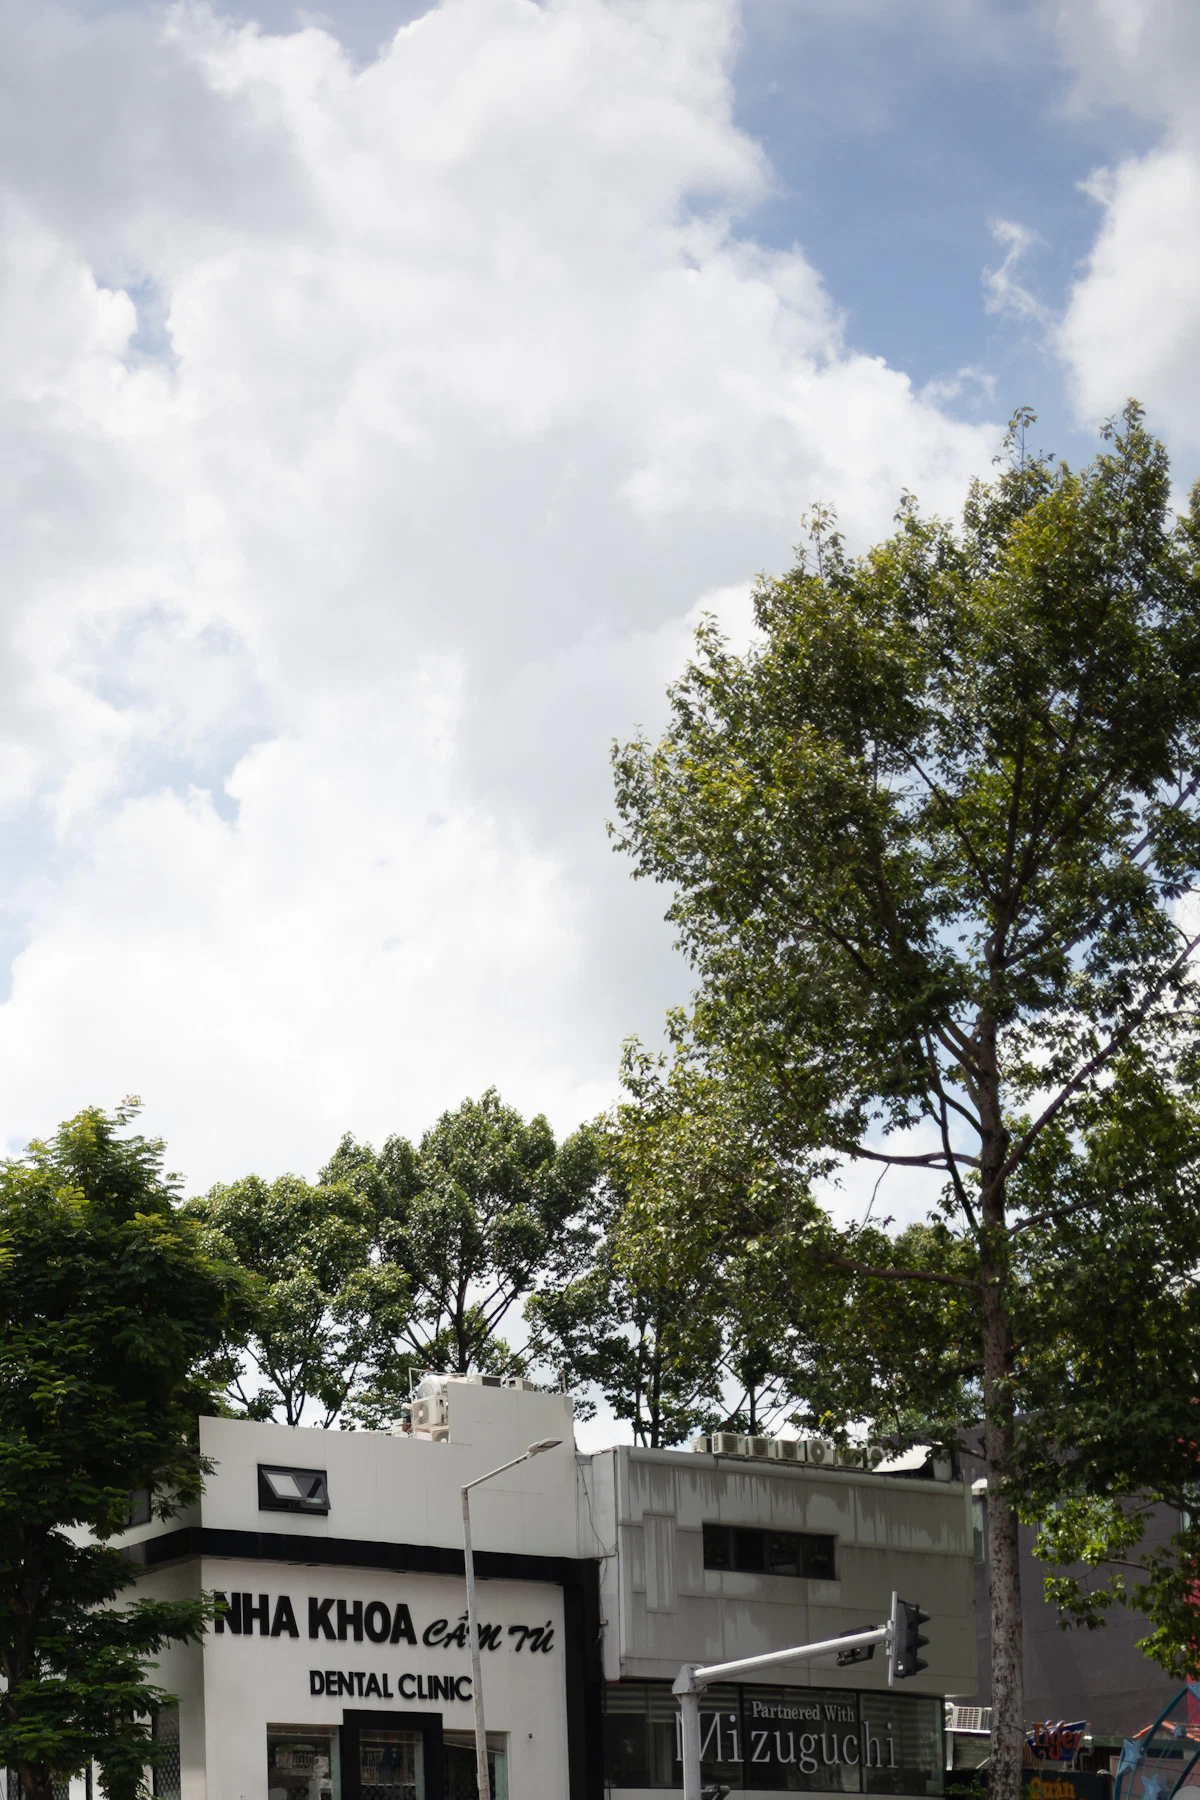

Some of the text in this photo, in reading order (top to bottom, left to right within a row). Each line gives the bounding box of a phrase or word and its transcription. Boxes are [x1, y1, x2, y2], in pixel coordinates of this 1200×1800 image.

[214, 1591, 299, 1637] NHA
[308, 1597, 418, 1645] KHOA
[508, 1620, 555, 1653] TÚ
[309, 1670, 473, 1701] DENTAL CLINIC
[752, 1701, 855, 1723] Partnered With
[675, 1711, 899, 1774] Mizuguchi
[1031, 1720, 1083, 1760] Tiger
